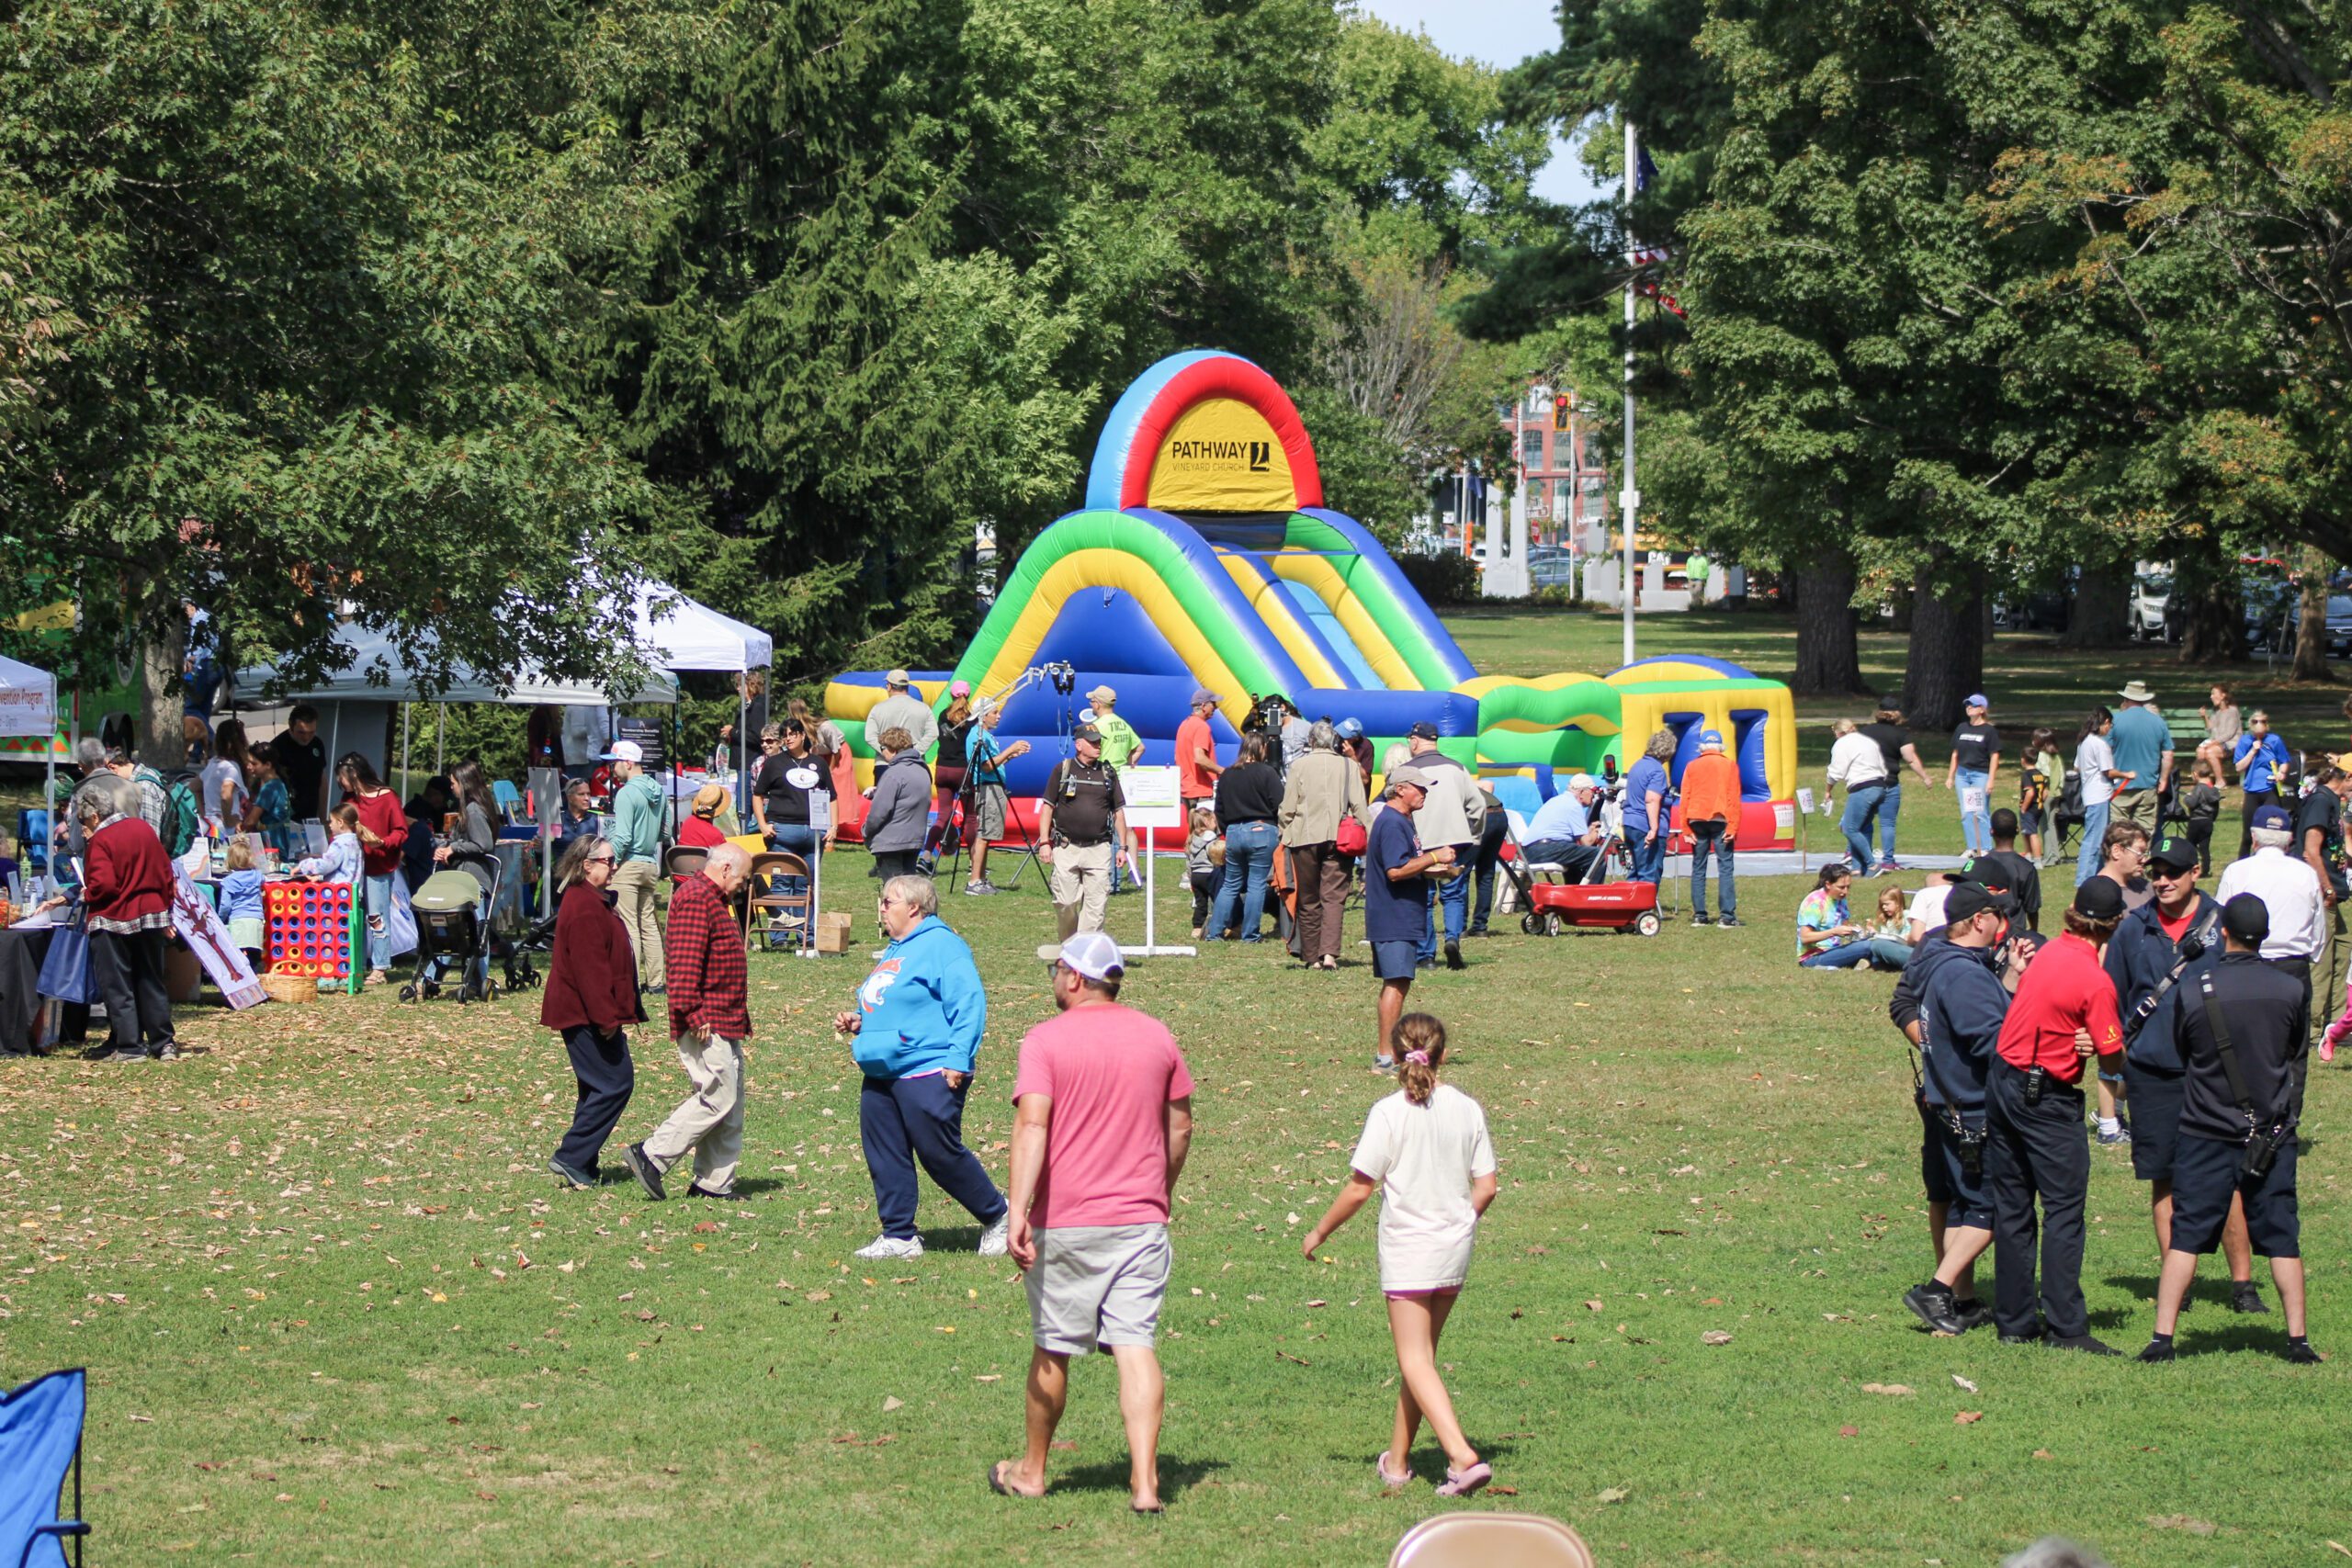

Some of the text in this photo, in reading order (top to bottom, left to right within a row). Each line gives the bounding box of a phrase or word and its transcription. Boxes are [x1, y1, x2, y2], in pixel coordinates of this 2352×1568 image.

[1172, 441, 1247, 458] PATHWAY
[1172, 462, 1244, 472] VINEYARD CHURCH
[21, 688, 44, 711] Program
[2161, 840, 2171, 852] B
[1963, 860, 1974, 872] B
